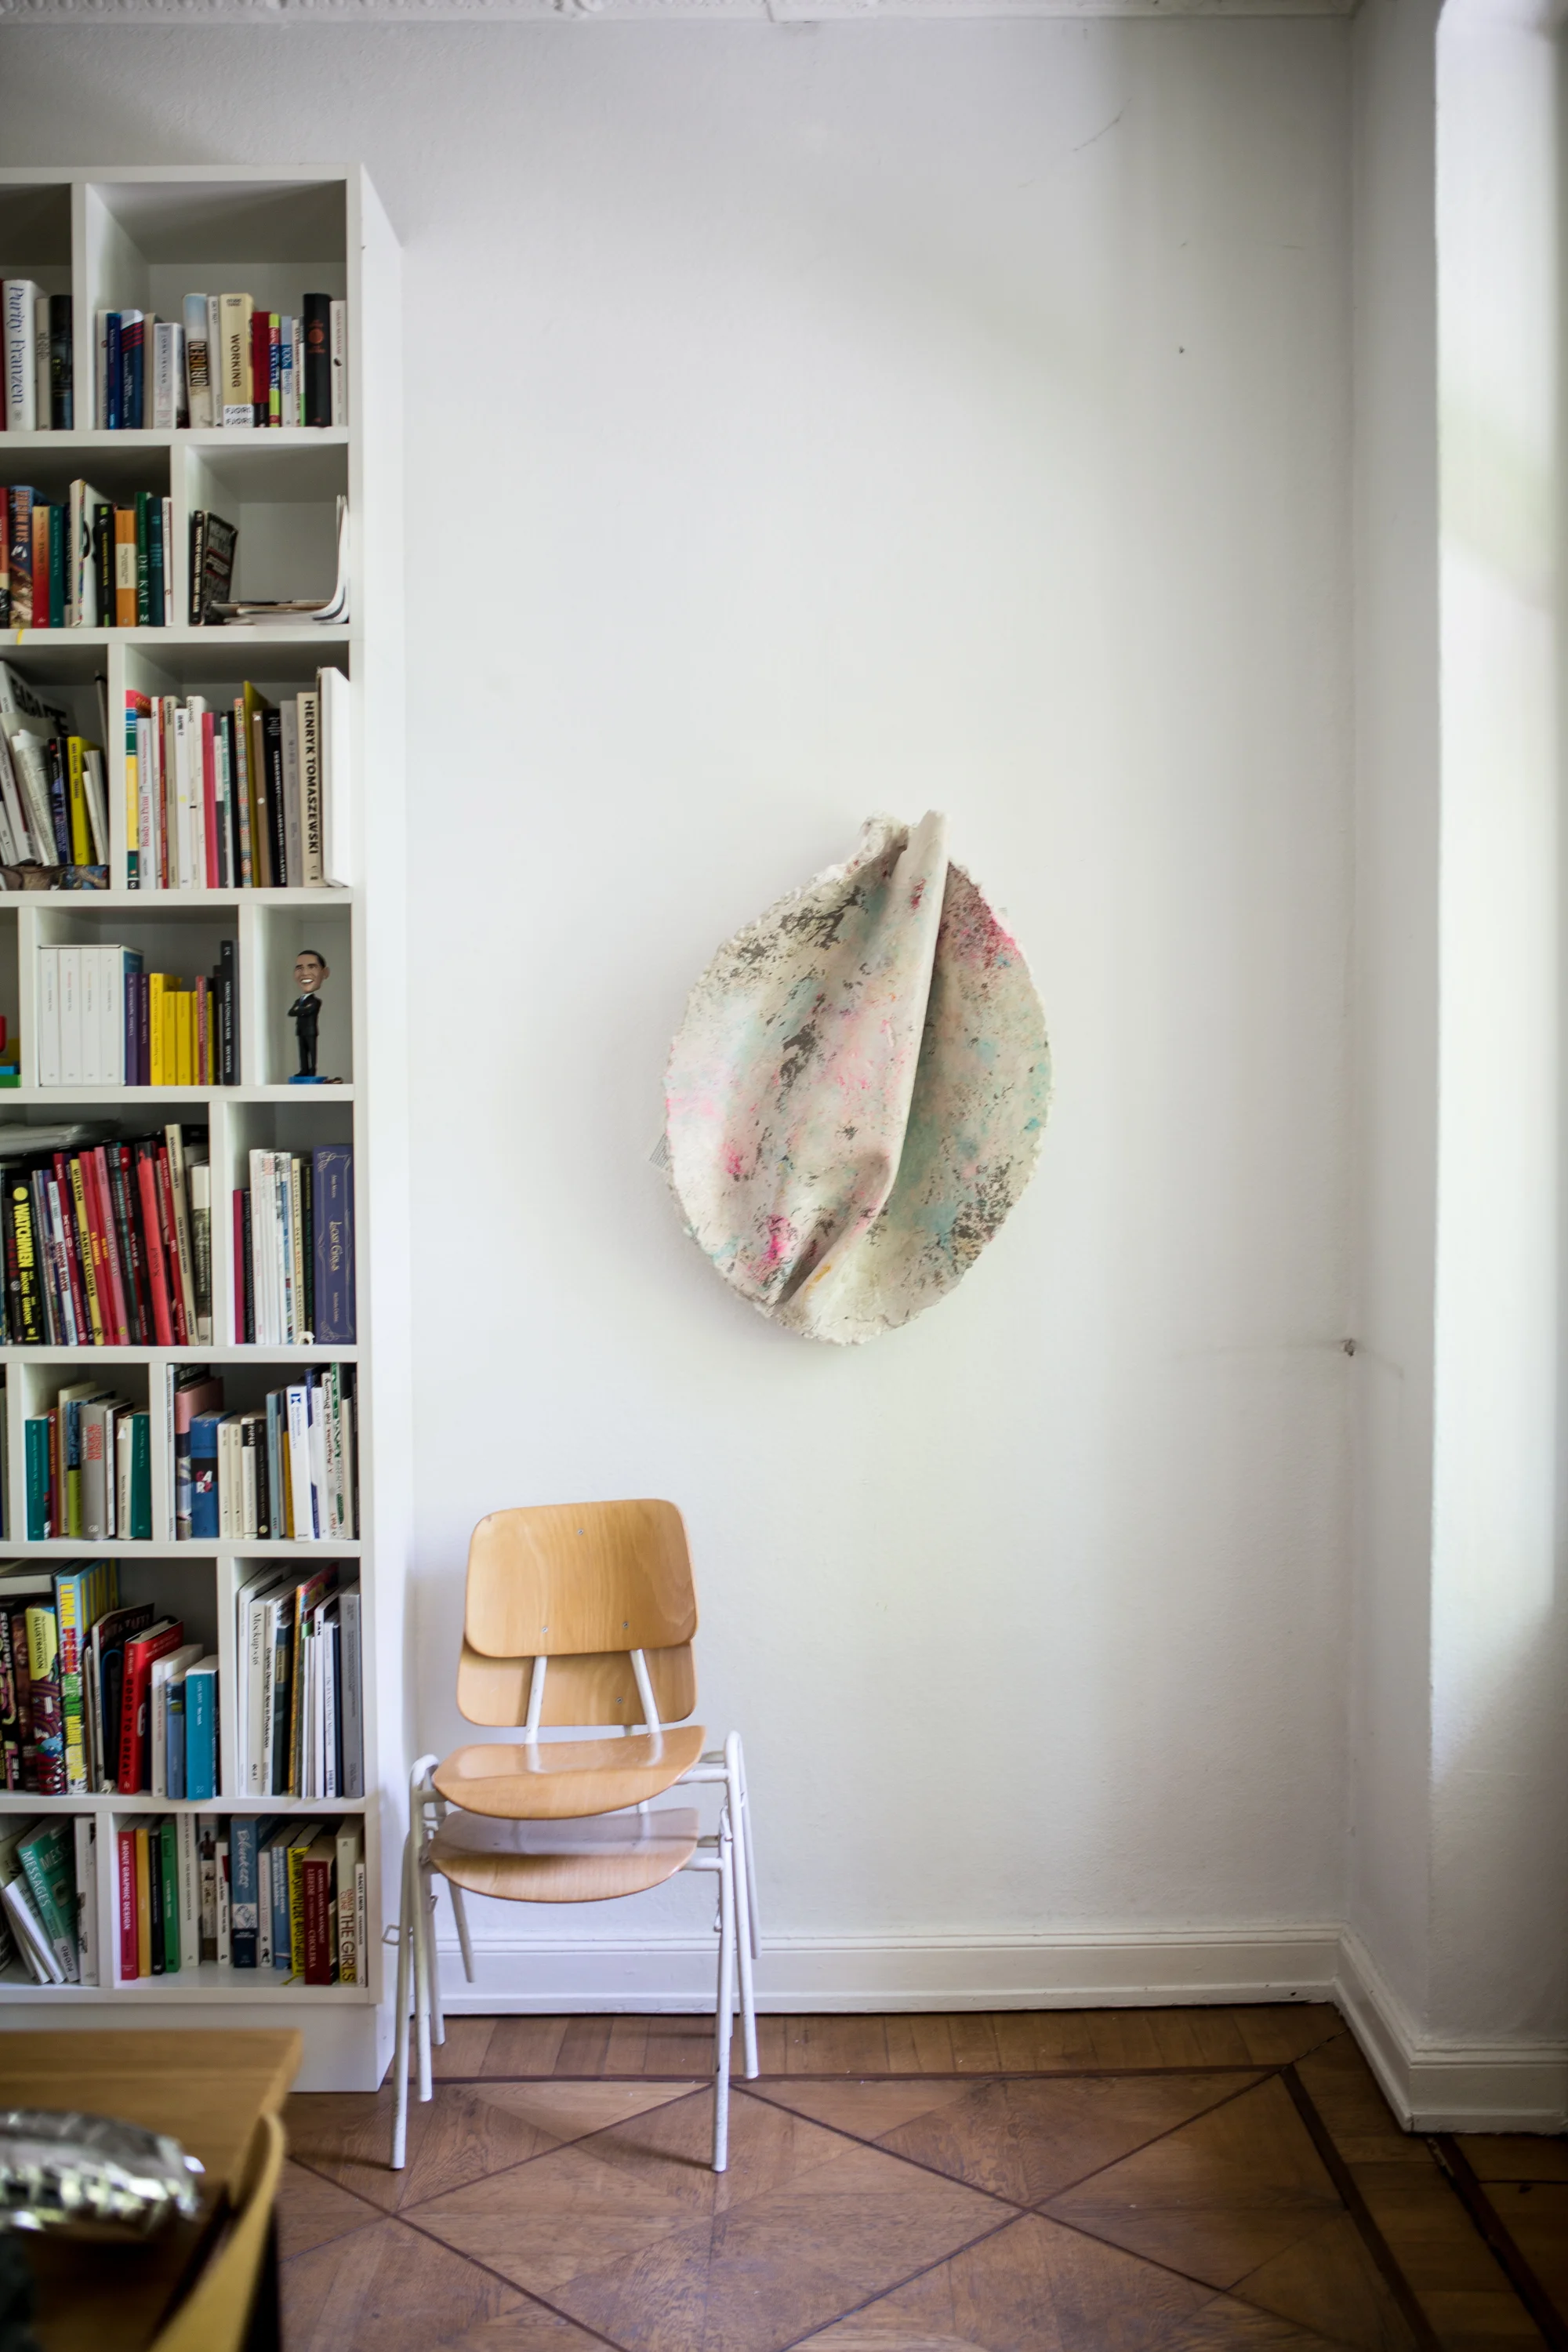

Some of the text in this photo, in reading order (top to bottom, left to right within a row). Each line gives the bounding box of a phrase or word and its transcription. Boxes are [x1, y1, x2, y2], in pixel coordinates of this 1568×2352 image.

[6, 287, 25, 405] Purity Franzen
[188, 343, 208, 386] DROGEN
[230, 334, 241, 387] WORKING
[16, 490, 30, 543] SAN MIGUEL
[194, 545, 201, 554] OF
[138, 555, 148, 605] DE KAT
[274, 750, 282, 793] JANKOWSKI
[304, 700, 319, 854] HENRYK TOMASZEWSKI
[141, 826, 150, 847] Ready
[13, 1202, 34, 1269] WATCHMEN
[72, 1168, 95, 1298] WILSON DANIEL CLOWES
[90, 1232, 100, 1265] EL BORBAH
[7, 1239, 19, 1277] MAUS
[20, 1271, 30, 1294] MOORE
[22, 1298, 32, 1324] GIBBONS
[326, 1429, 335, 1465] Magazine
[60, 1583, 74, 1628] LIMA
[33, 1617, 44, 1669] ILLUSTRATION
[62, 1628, 78, 1672] PERU
[67, 1715, 82, 1745] MARIO
[122, 1679, 133, 1776] GOOD TO GREAT
[22, 1850, 51, 1907] MESSAGES
[122, 1866, 130, 1900] GRAPHIC
[122, 1900, 131, 1929] DESIGN
[60, 1944, 74, 1973] FJORD
[307, 1929, 316, 1969] CHOLERA
[340, 1913, 357, 1982] THE GIRLS
